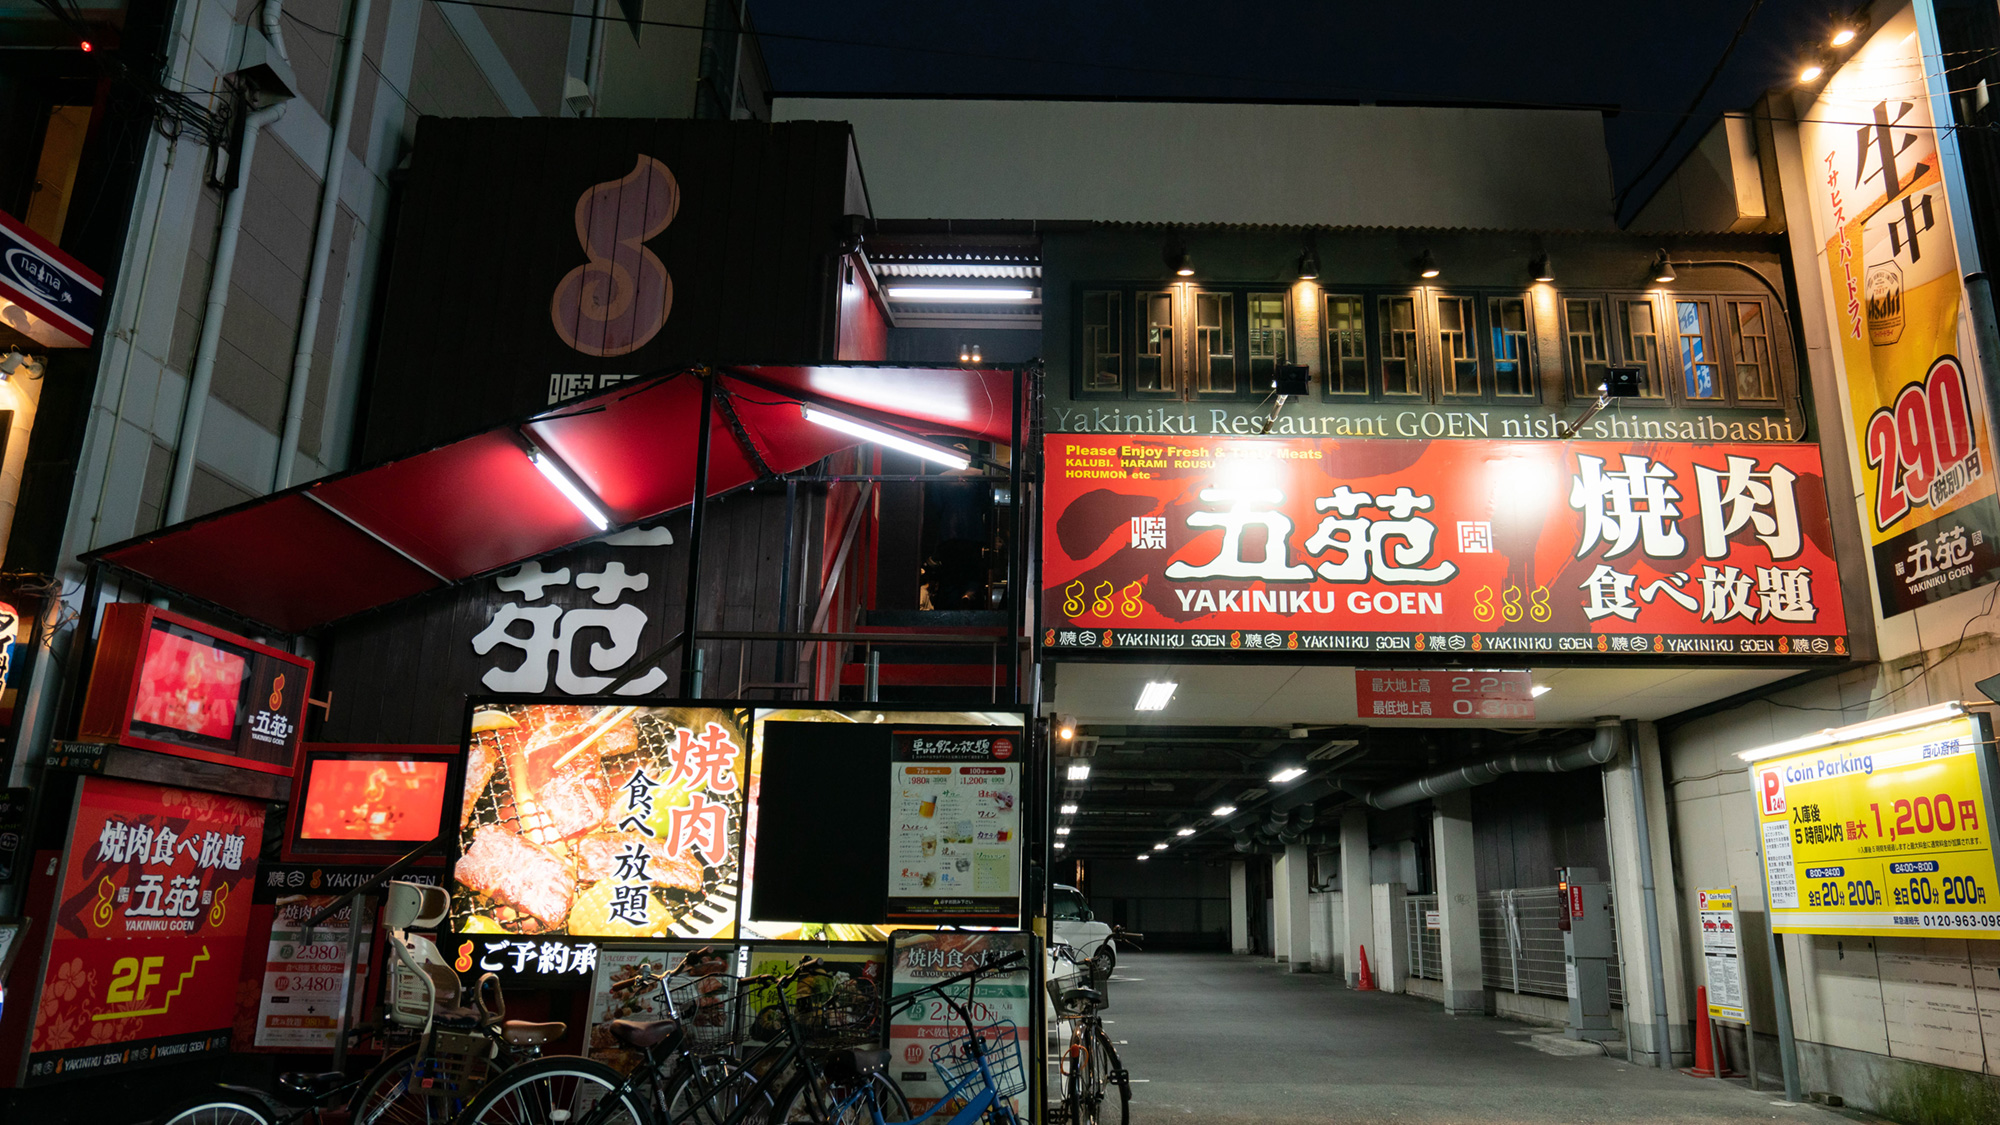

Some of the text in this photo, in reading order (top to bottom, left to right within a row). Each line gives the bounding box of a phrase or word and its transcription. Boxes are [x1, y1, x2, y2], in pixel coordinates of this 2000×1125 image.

[1855, 100, 1935, 264] 生中
[1824, 150, 1861, 340] アサヒスーパードライ
[1053, 407, 1198, 434] Yakiniku
[1210, 408, 1388, 436] Restaurant
[1395, 412, 1489, 438] GOEN
[1066, 445, 1117, 456] Please
[1121, 445, 1163, 460] Enjoy
[1167, 446, 1210, 458] Fresh
[1215, 446, 1226, 458] &
[1277, 448, 1323, 460] Meats
[1868, 359, 1973, 528] 290
[1066, 470, 1151, 480] HORUMON etc
[1121, 459, 1167, 468] HARAMI
[1174, 459, 1216, 469] ROUSU
[1569, 452, 1802, 562] 焼肉
[1164, 485, 1460, 585] 五苑
[1579, 563, 1818, 625] 食べ放題
[1908, 564, 1974, 595] YAKINIKU GOEN
[472, 526, 675, 696] 苑
[1175, 589, 1443, 615] YAKINIKU GOEN
[1117, 633, 1185, 647] YAKINIKU
[1191, 633, 1226, 647] GOEN
[1302, 635, 1370, 649] YAKINIKU
[1376, 636, 1410, 649] GOEN
[1486, 637, 1552, 650] YAKINIKU
[1559, 637, 1592, 650] GOEN
[1667, 638, 1734, 652] YAKINIKU
[1740, 638, 1775, 652] GOEN
[1372, 676, 1527, 693] 最大地上高 2.2m
[1373, 700, 1433, 716] 最低地上高
[64, 744, 103, 755] YAKINIKU
[1786, 752, 1874, 783] Coin Parking
[664, 722, 738, 866] 焼肉
[1763, 771, 1780, 812] P
[1772, 797, 1786, 811] 24h
[1793, 804, 1821, 825] 入庫後
[96, 819, 245, 871] 焼肉食べ放題
[608, 768, 660, 927] 食べ放題
[124, 874, 201, 918] 五苑
[125, 920, 195, 931] YAKINIKU GOEN
[106, 955, 165, 1004] 2F
[926, 970, 941, 978] YOU
[64, 1055, 101, 1072] YAKINIKU
[103, 1052, 122, 1067] GOEN
[157, 1043, 188, 1057] YAKINIKU
[188, 1041, 205, 1052] GOEN
